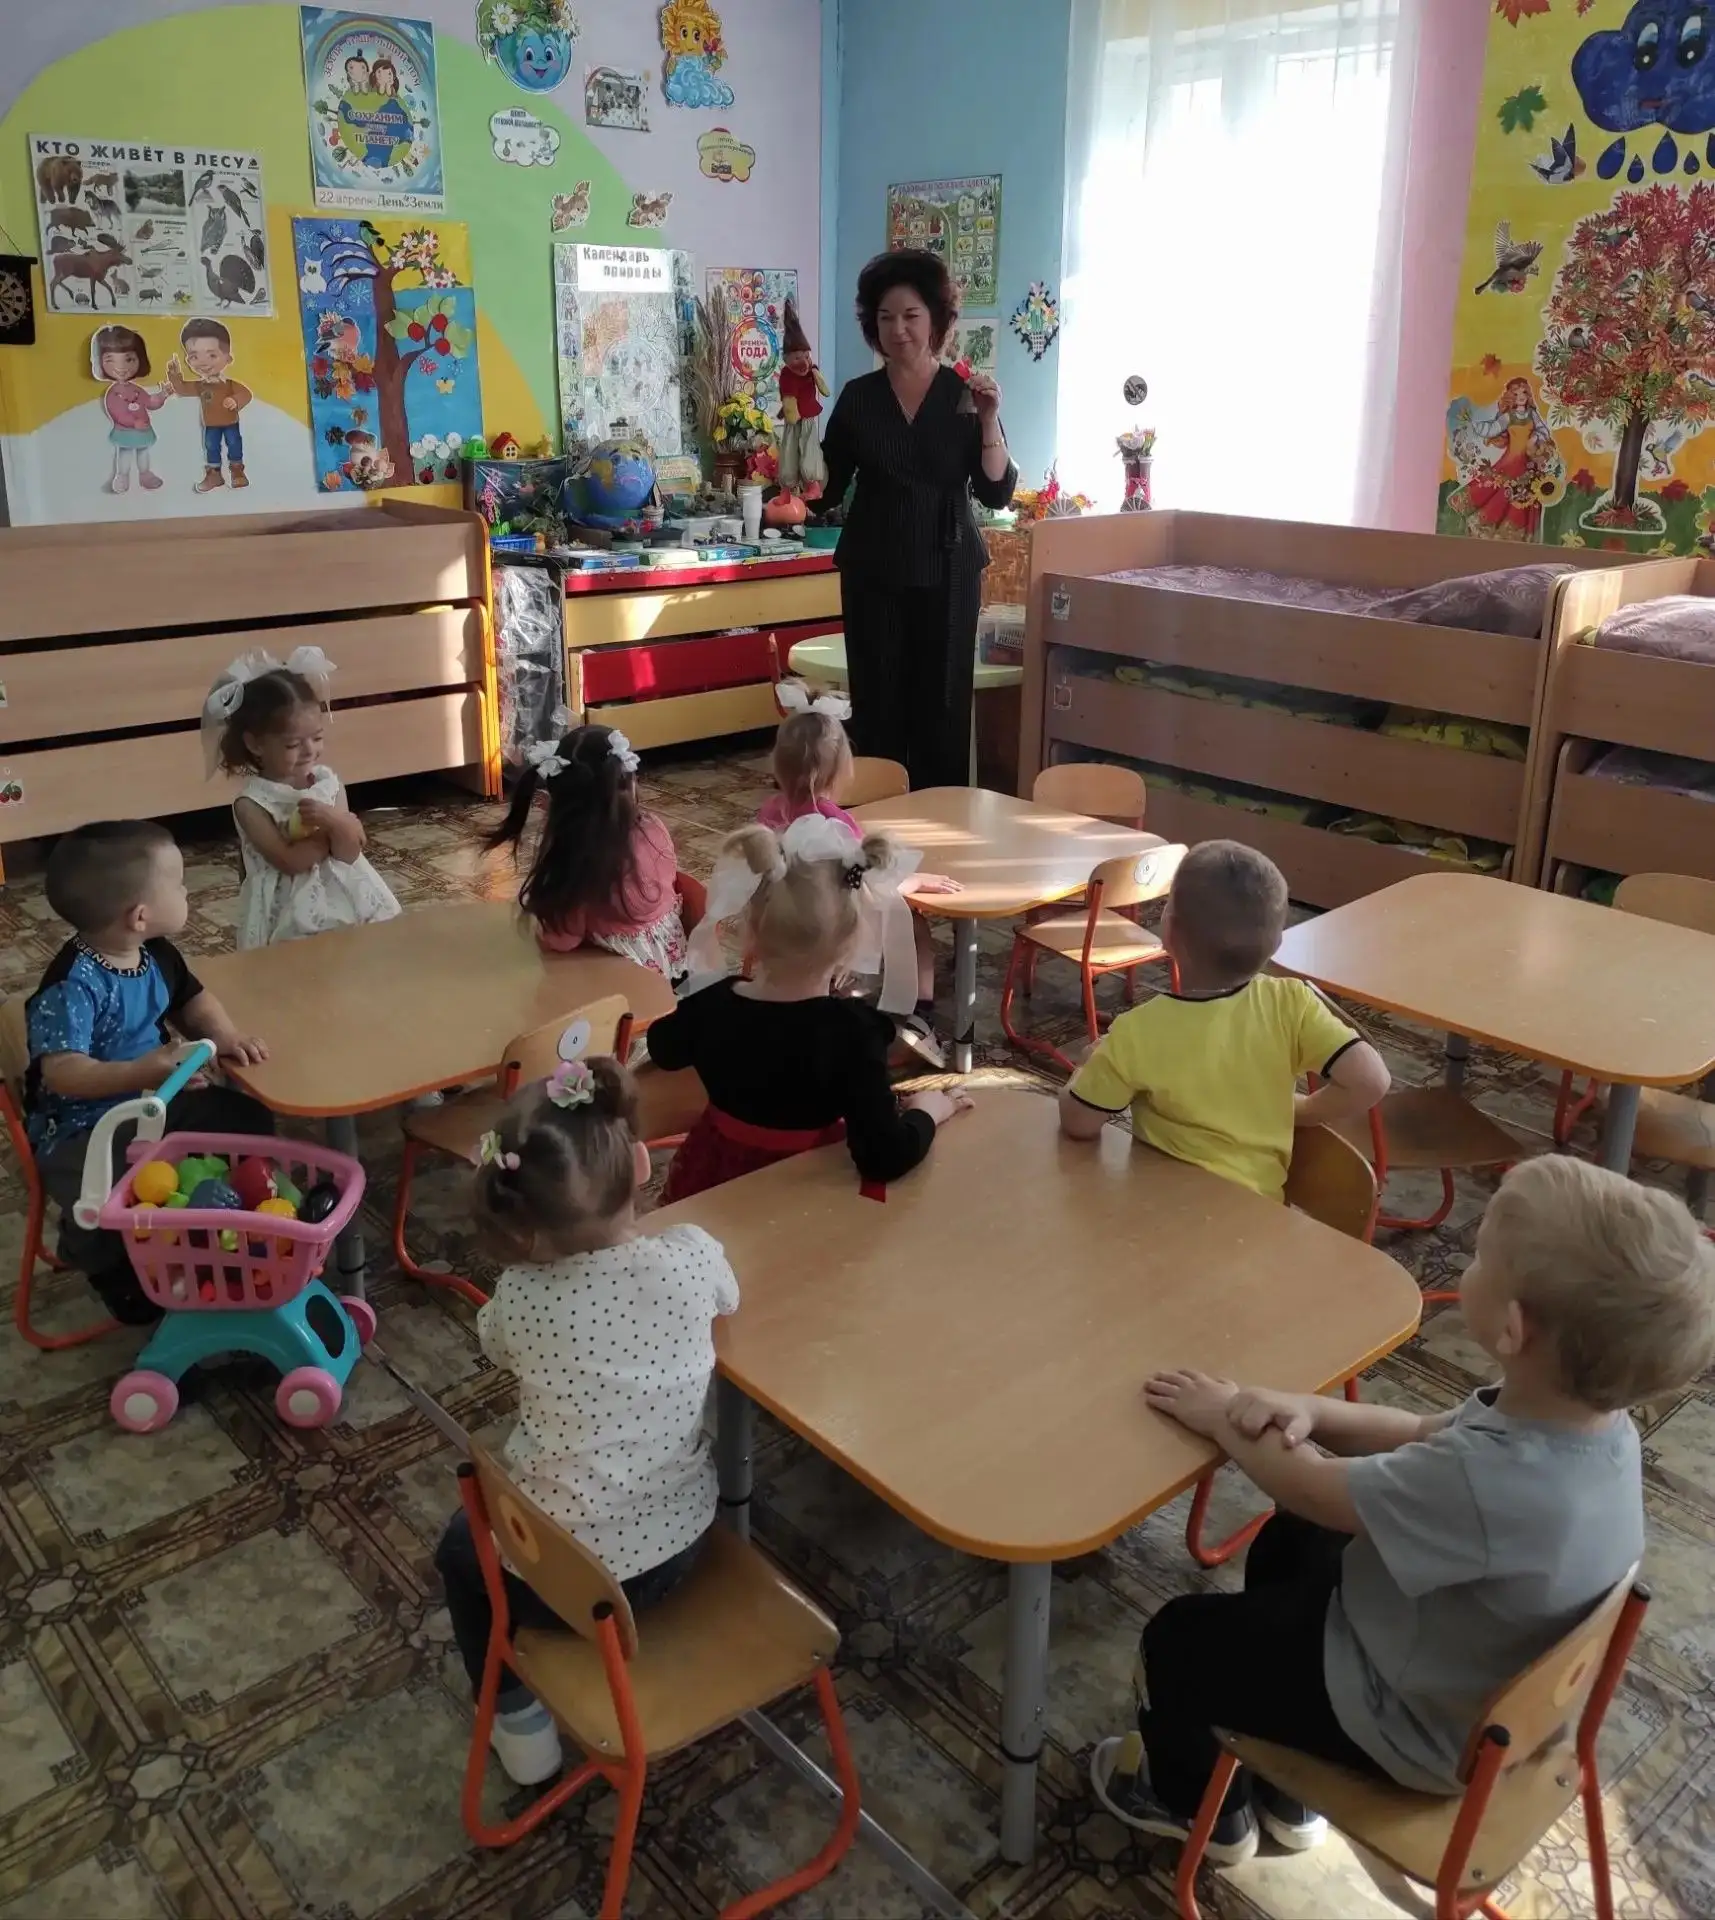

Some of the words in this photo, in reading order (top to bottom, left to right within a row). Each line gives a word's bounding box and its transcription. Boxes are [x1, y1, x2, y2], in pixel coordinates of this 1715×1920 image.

[36, 140, 80, 156] КТО
[91, 144, 163, 163] ЖИВЁТ
[174, 151, 185, 164] В
[194, 153, 244, 169] ЛЕСУ
[319, 191, 334, 204] 22
[407, 196, 443, 210] Земли
[583, 247, 650, 263] Календарь
[740, 346, 768, 359] ГОДА
